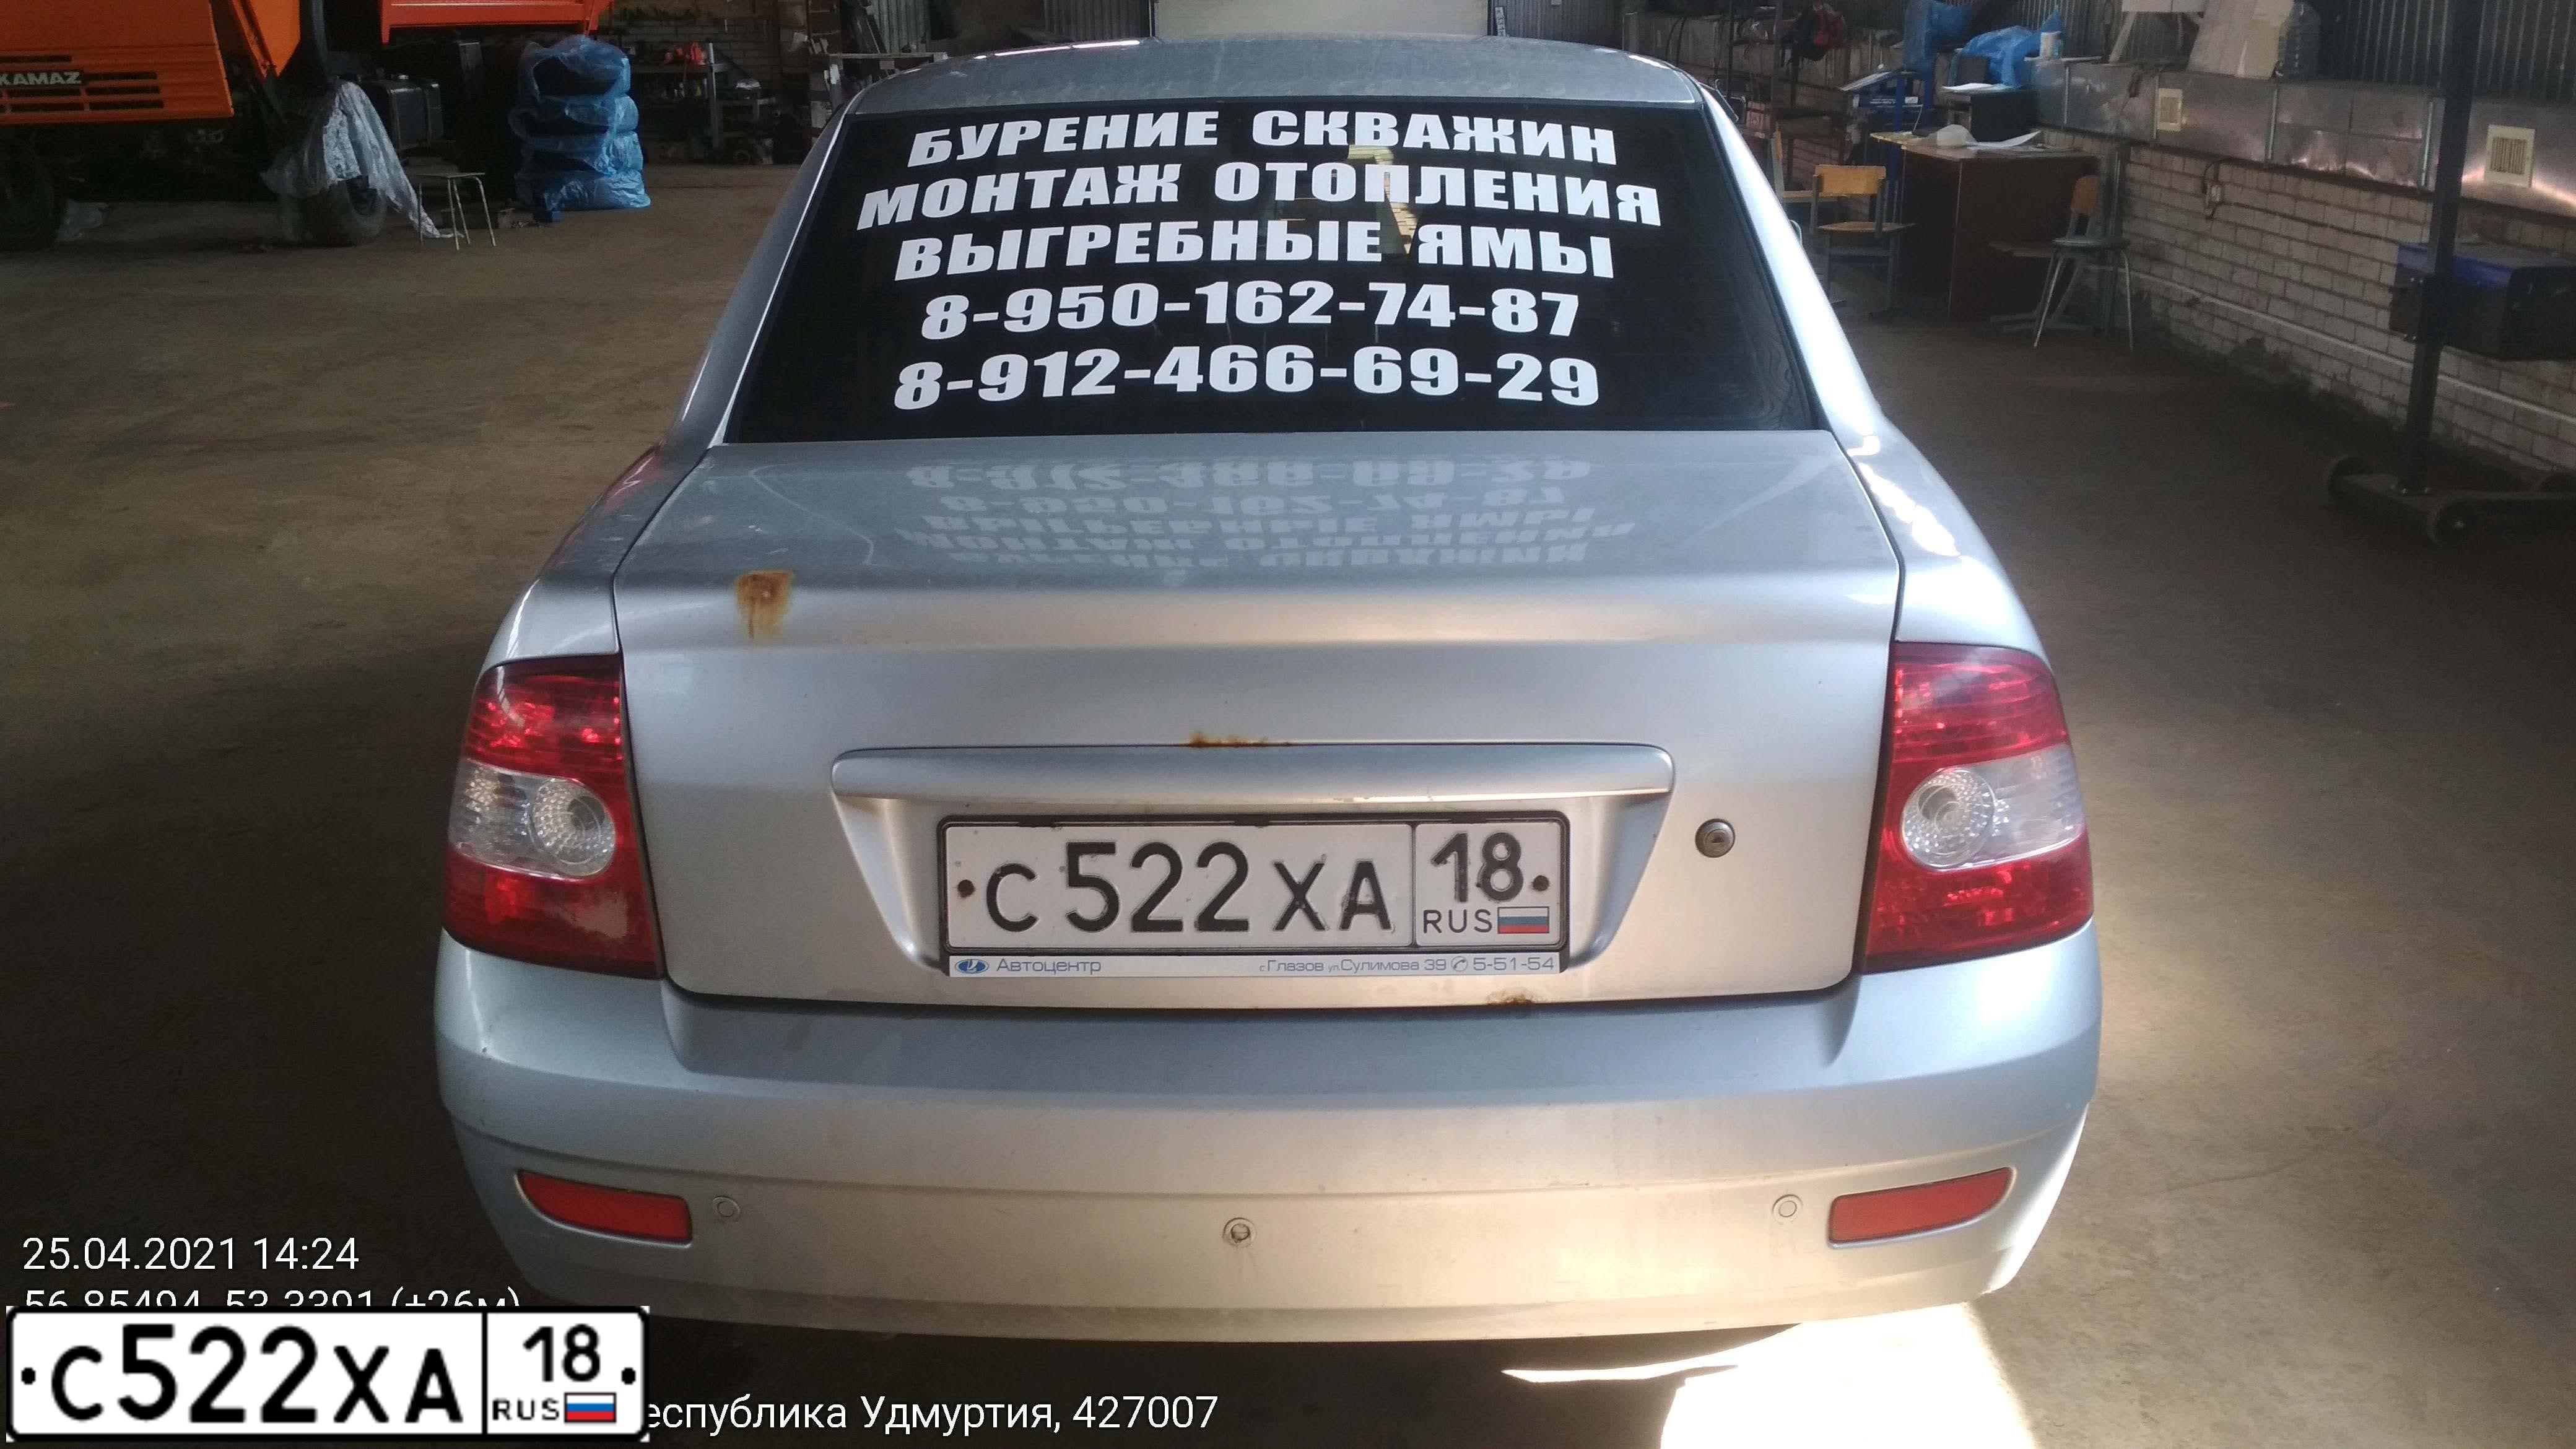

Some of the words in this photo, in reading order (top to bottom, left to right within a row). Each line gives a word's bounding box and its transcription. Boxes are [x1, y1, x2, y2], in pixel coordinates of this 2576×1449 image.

[907, 111, 1219, 167] БУРЕНИЕ
[1252, 110, 1616, 165] СКВАЖИН
[856, 163, 1181, 230] МОНТАЖ
[1214, 162, 1661, 226] ОТОПЛЕНИЯ
[894, 220, 1382, 281] ВЫГРЕБНЫЕ
[1418, 224, 1614, 279] ЯМЫ
[921, 280, 1579, 340] 8-950-162-74-87
[894, 344, 1599, 410] 8-912-466-69-29
[1430, 832, 1524, 903] 18
[1422, 908, 1493, 934] RUS
[996, 958, 1102, 975] Автоцентр
[1424, 958, 1447, 971] 39
[1473, 957, 1554, 971] 5-51-54
